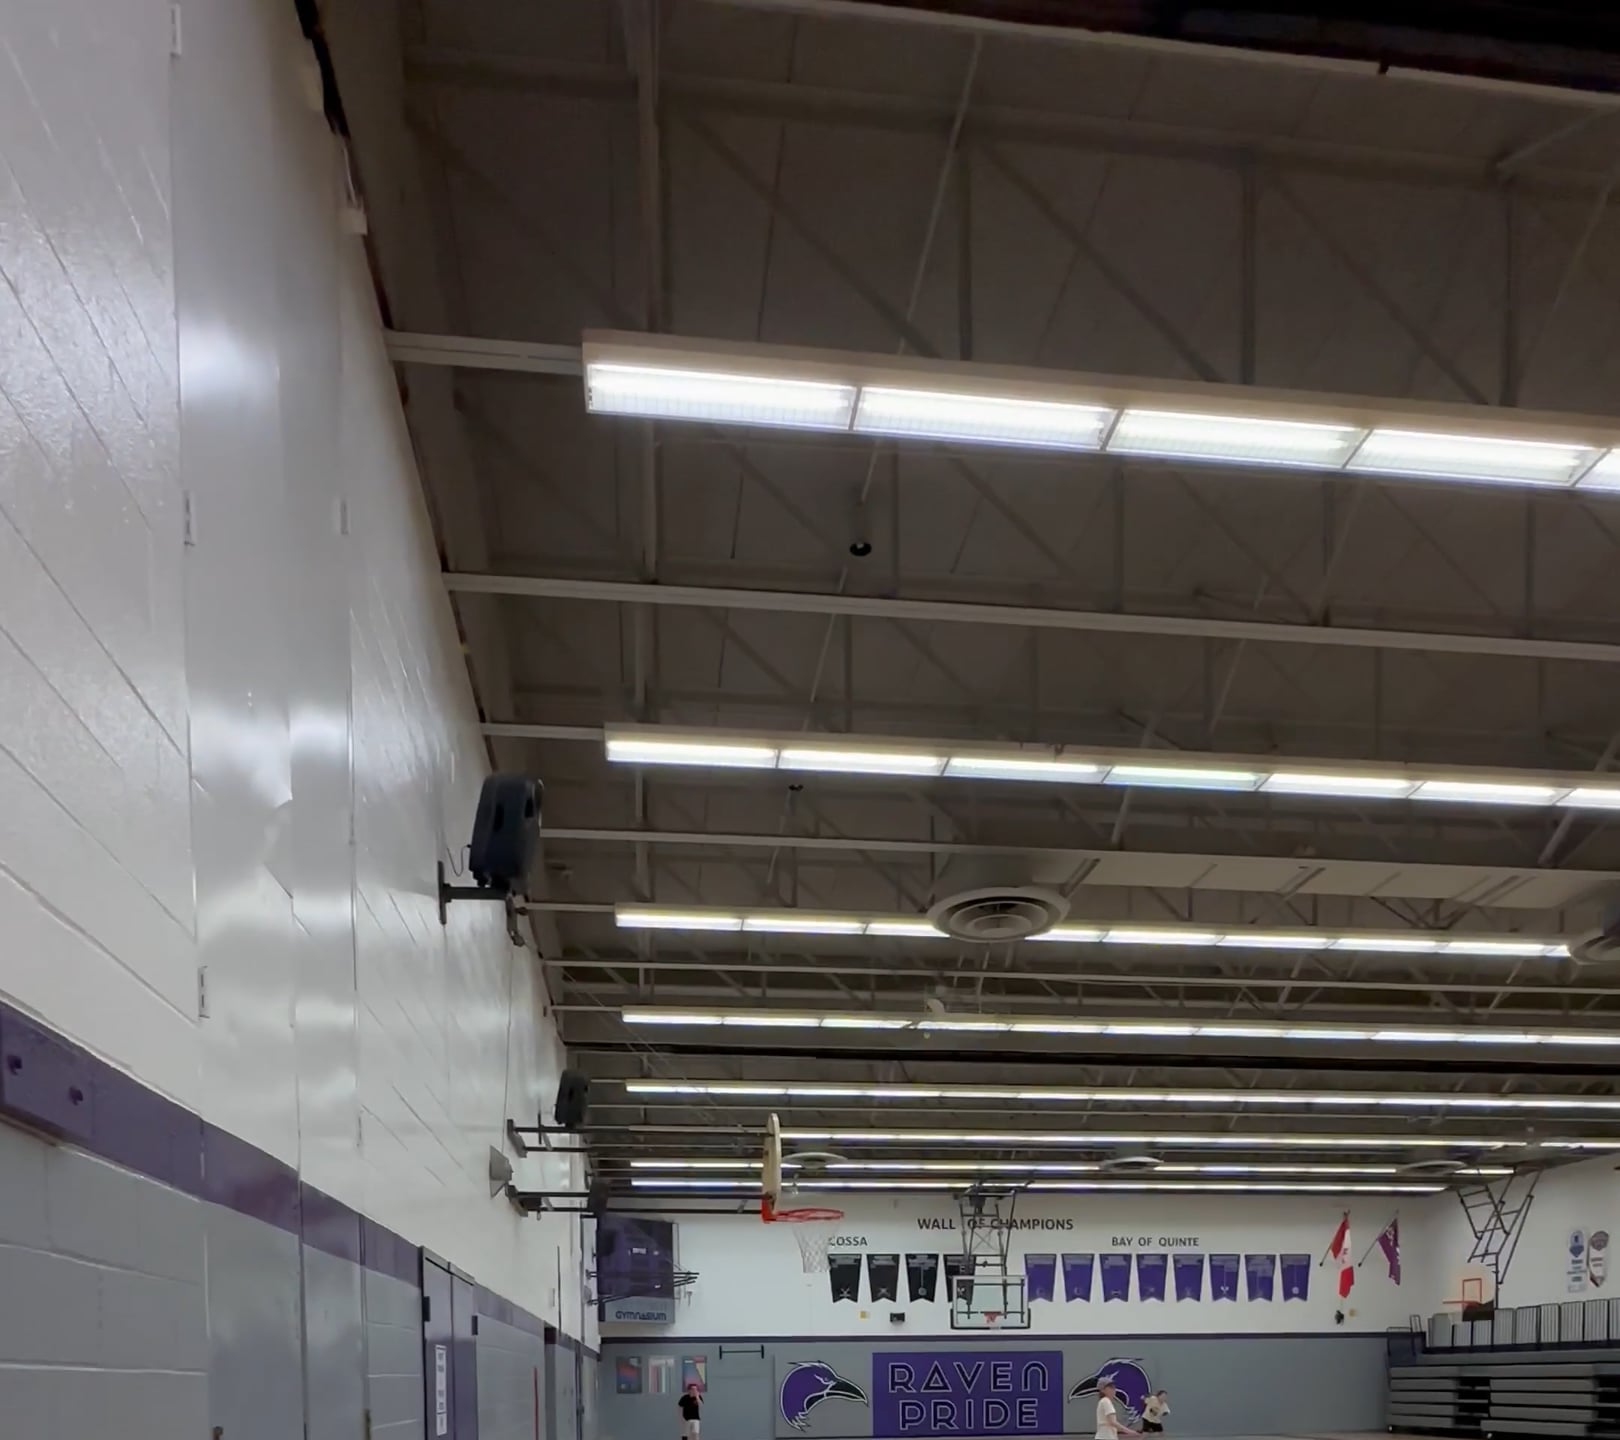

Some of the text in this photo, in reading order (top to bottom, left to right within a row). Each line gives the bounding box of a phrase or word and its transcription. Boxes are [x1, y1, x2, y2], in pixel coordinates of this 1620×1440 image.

[917, 1218, 1074, 1231] WALL OF CHAMPIONS
[828, 1236, 868, 1247] COSSA
[1111, 1236, 1200, 1247] BAY OF QUINTE
[888, 1360, 1049, 1394] RAVEN
[899, 1398, 1039, 1431] PRIDE
